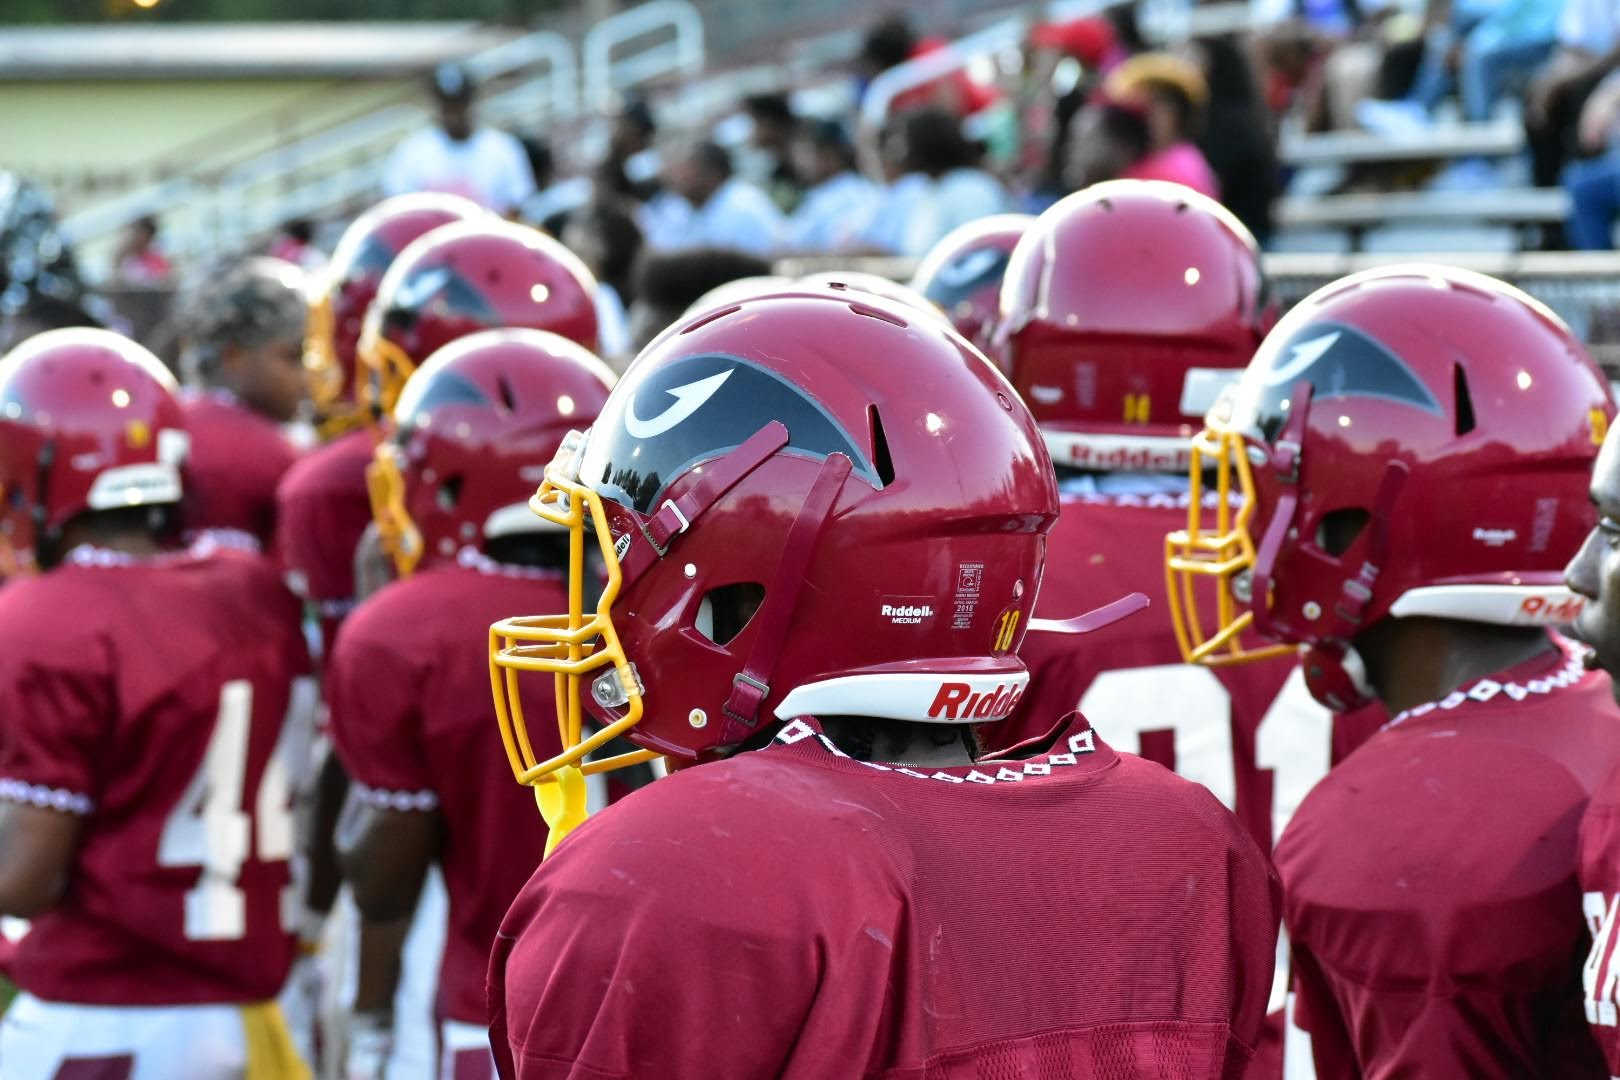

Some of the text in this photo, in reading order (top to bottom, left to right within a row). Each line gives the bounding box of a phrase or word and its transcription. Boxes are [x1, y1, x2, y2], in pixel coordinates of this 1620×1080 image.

[616, 534, 630, 558] dell
[882, 604, 929, 617] Riddell
[1521, 596, 1587, 620] Ridd
[891, 617, 921, 625] MEDIUM
[994, 610, 1020, 652] 10
[928, 682, 1021, 719] Ridde
